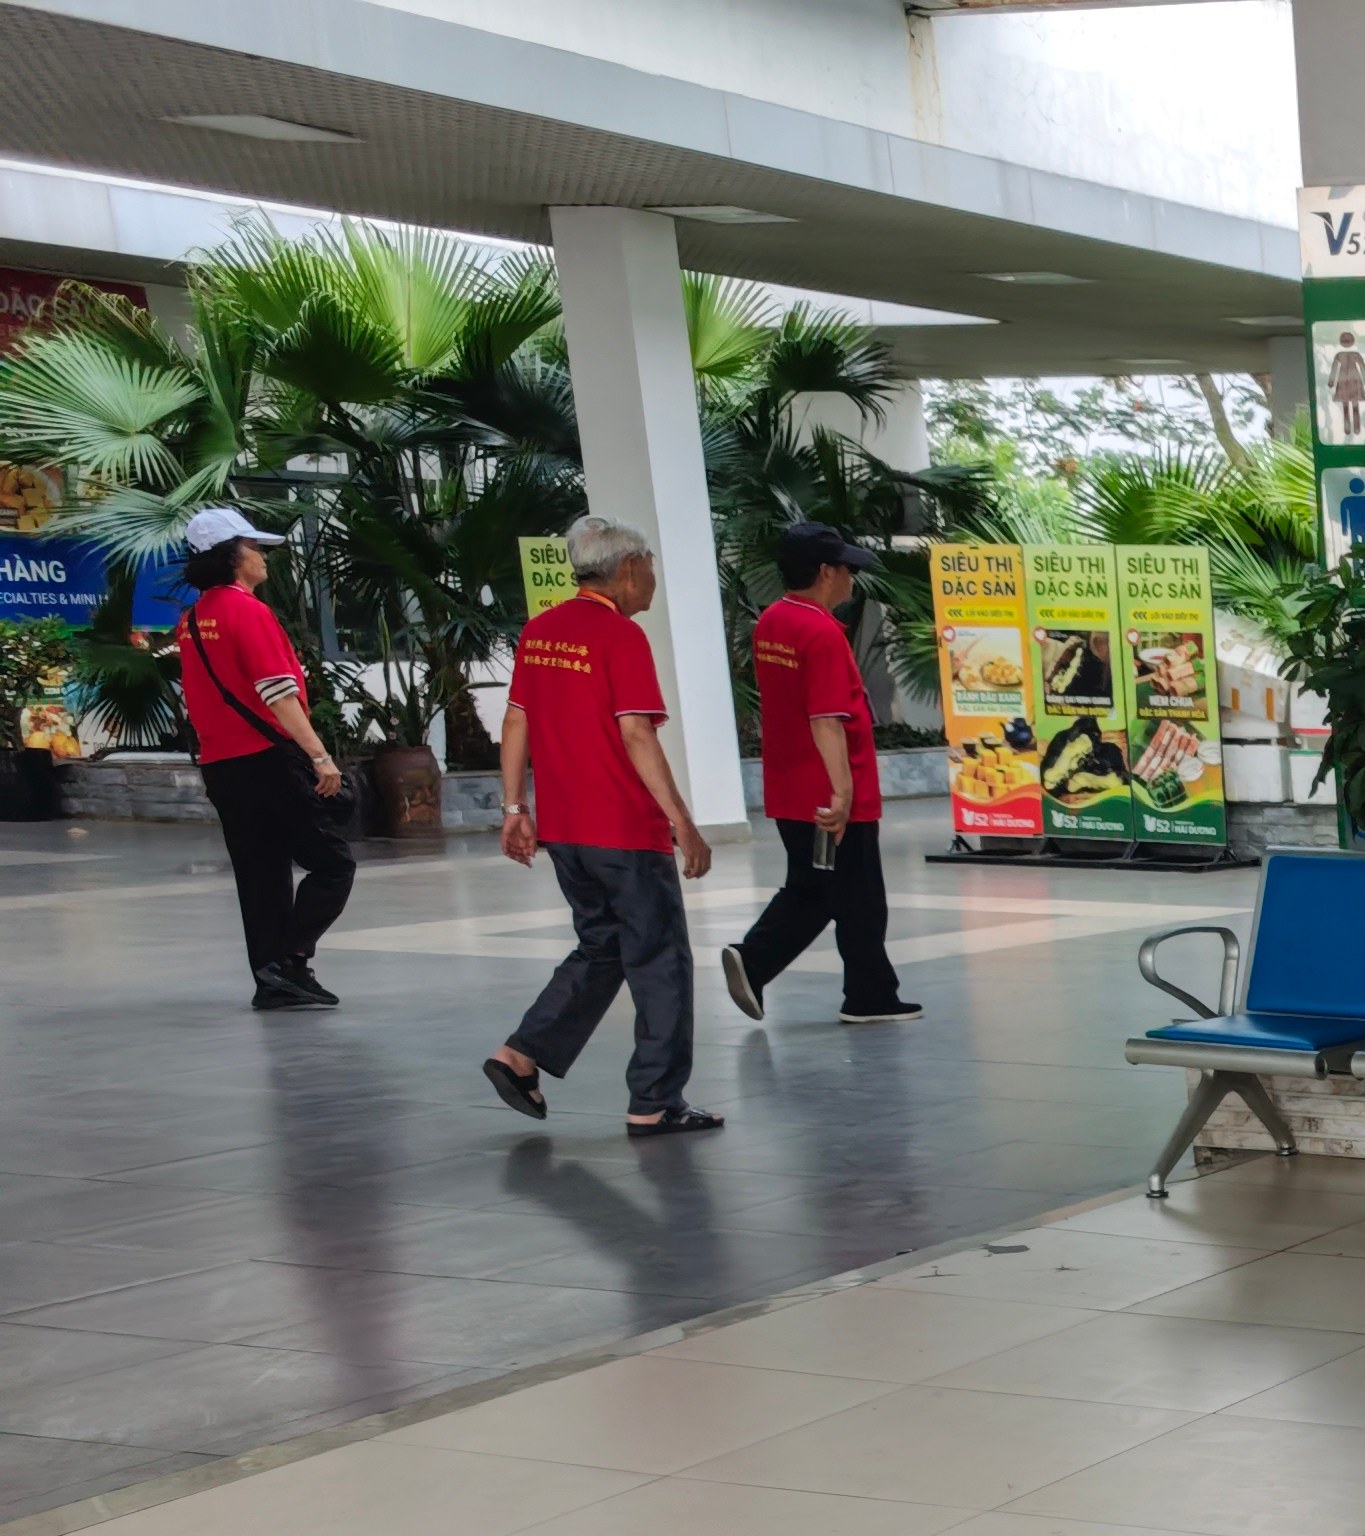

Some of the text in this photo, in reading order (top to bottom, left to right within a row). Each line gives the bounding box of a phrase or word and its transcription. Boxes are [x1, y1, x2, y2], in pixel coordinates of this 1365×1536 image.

[530, 544, 567, 565] SIÊU
[941, 552, 1013, 577] SIÊU THỊ
[1033, 552, 1106, 579] SIÊU THỊ
[1127, 554, 1199, 581] SIÊU THỊ
[531, 568, 566, 593] ĐẶC
[942, 576, 1016, 600] ĐẶC SẢN
[1034, 576, 1108, 602] ĐẶC SẢN
[1128, 577, 1202, 603] ĐẶC SẢN
[60, 593, 68, 605] &
[70, 594, 96, 605] MINI
[1149, 695, 1169, 706] NEM
